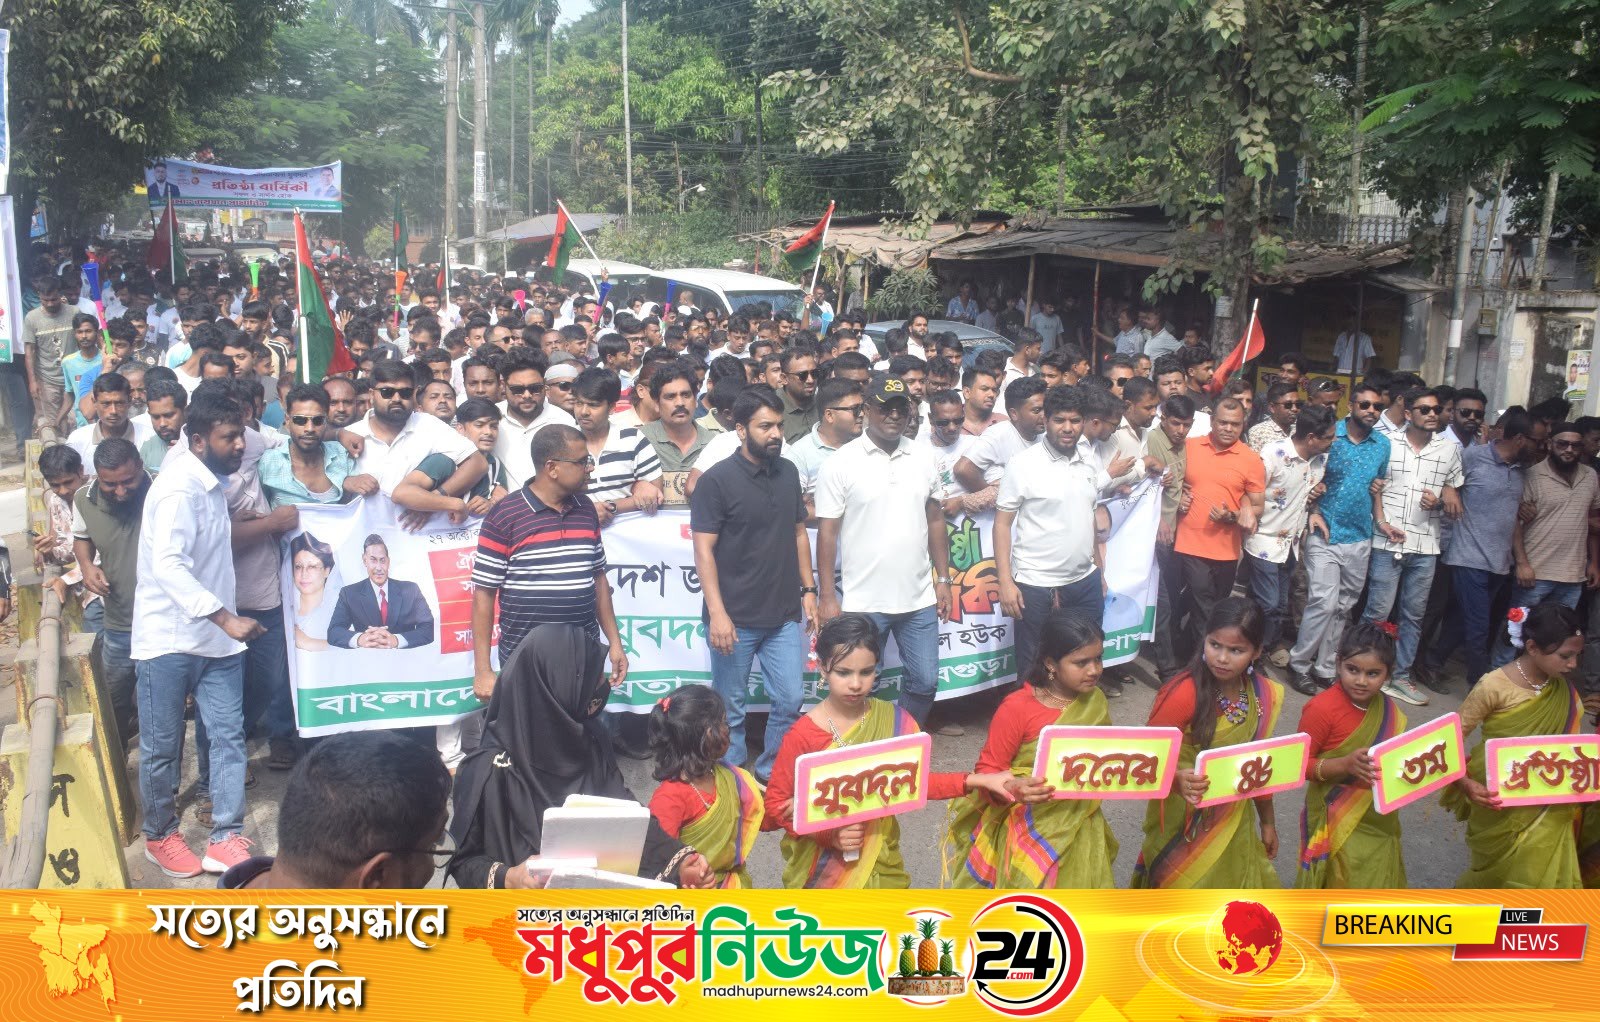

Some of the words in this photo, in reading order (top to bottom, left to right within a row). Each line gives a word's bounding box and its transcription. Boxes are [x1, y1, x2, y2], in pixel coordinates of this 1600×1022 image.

[957, 623, 1007, 648] হউক
[814, 760, 919, 814] যুবদল
[1061, 752, 1158, 788] দলের
